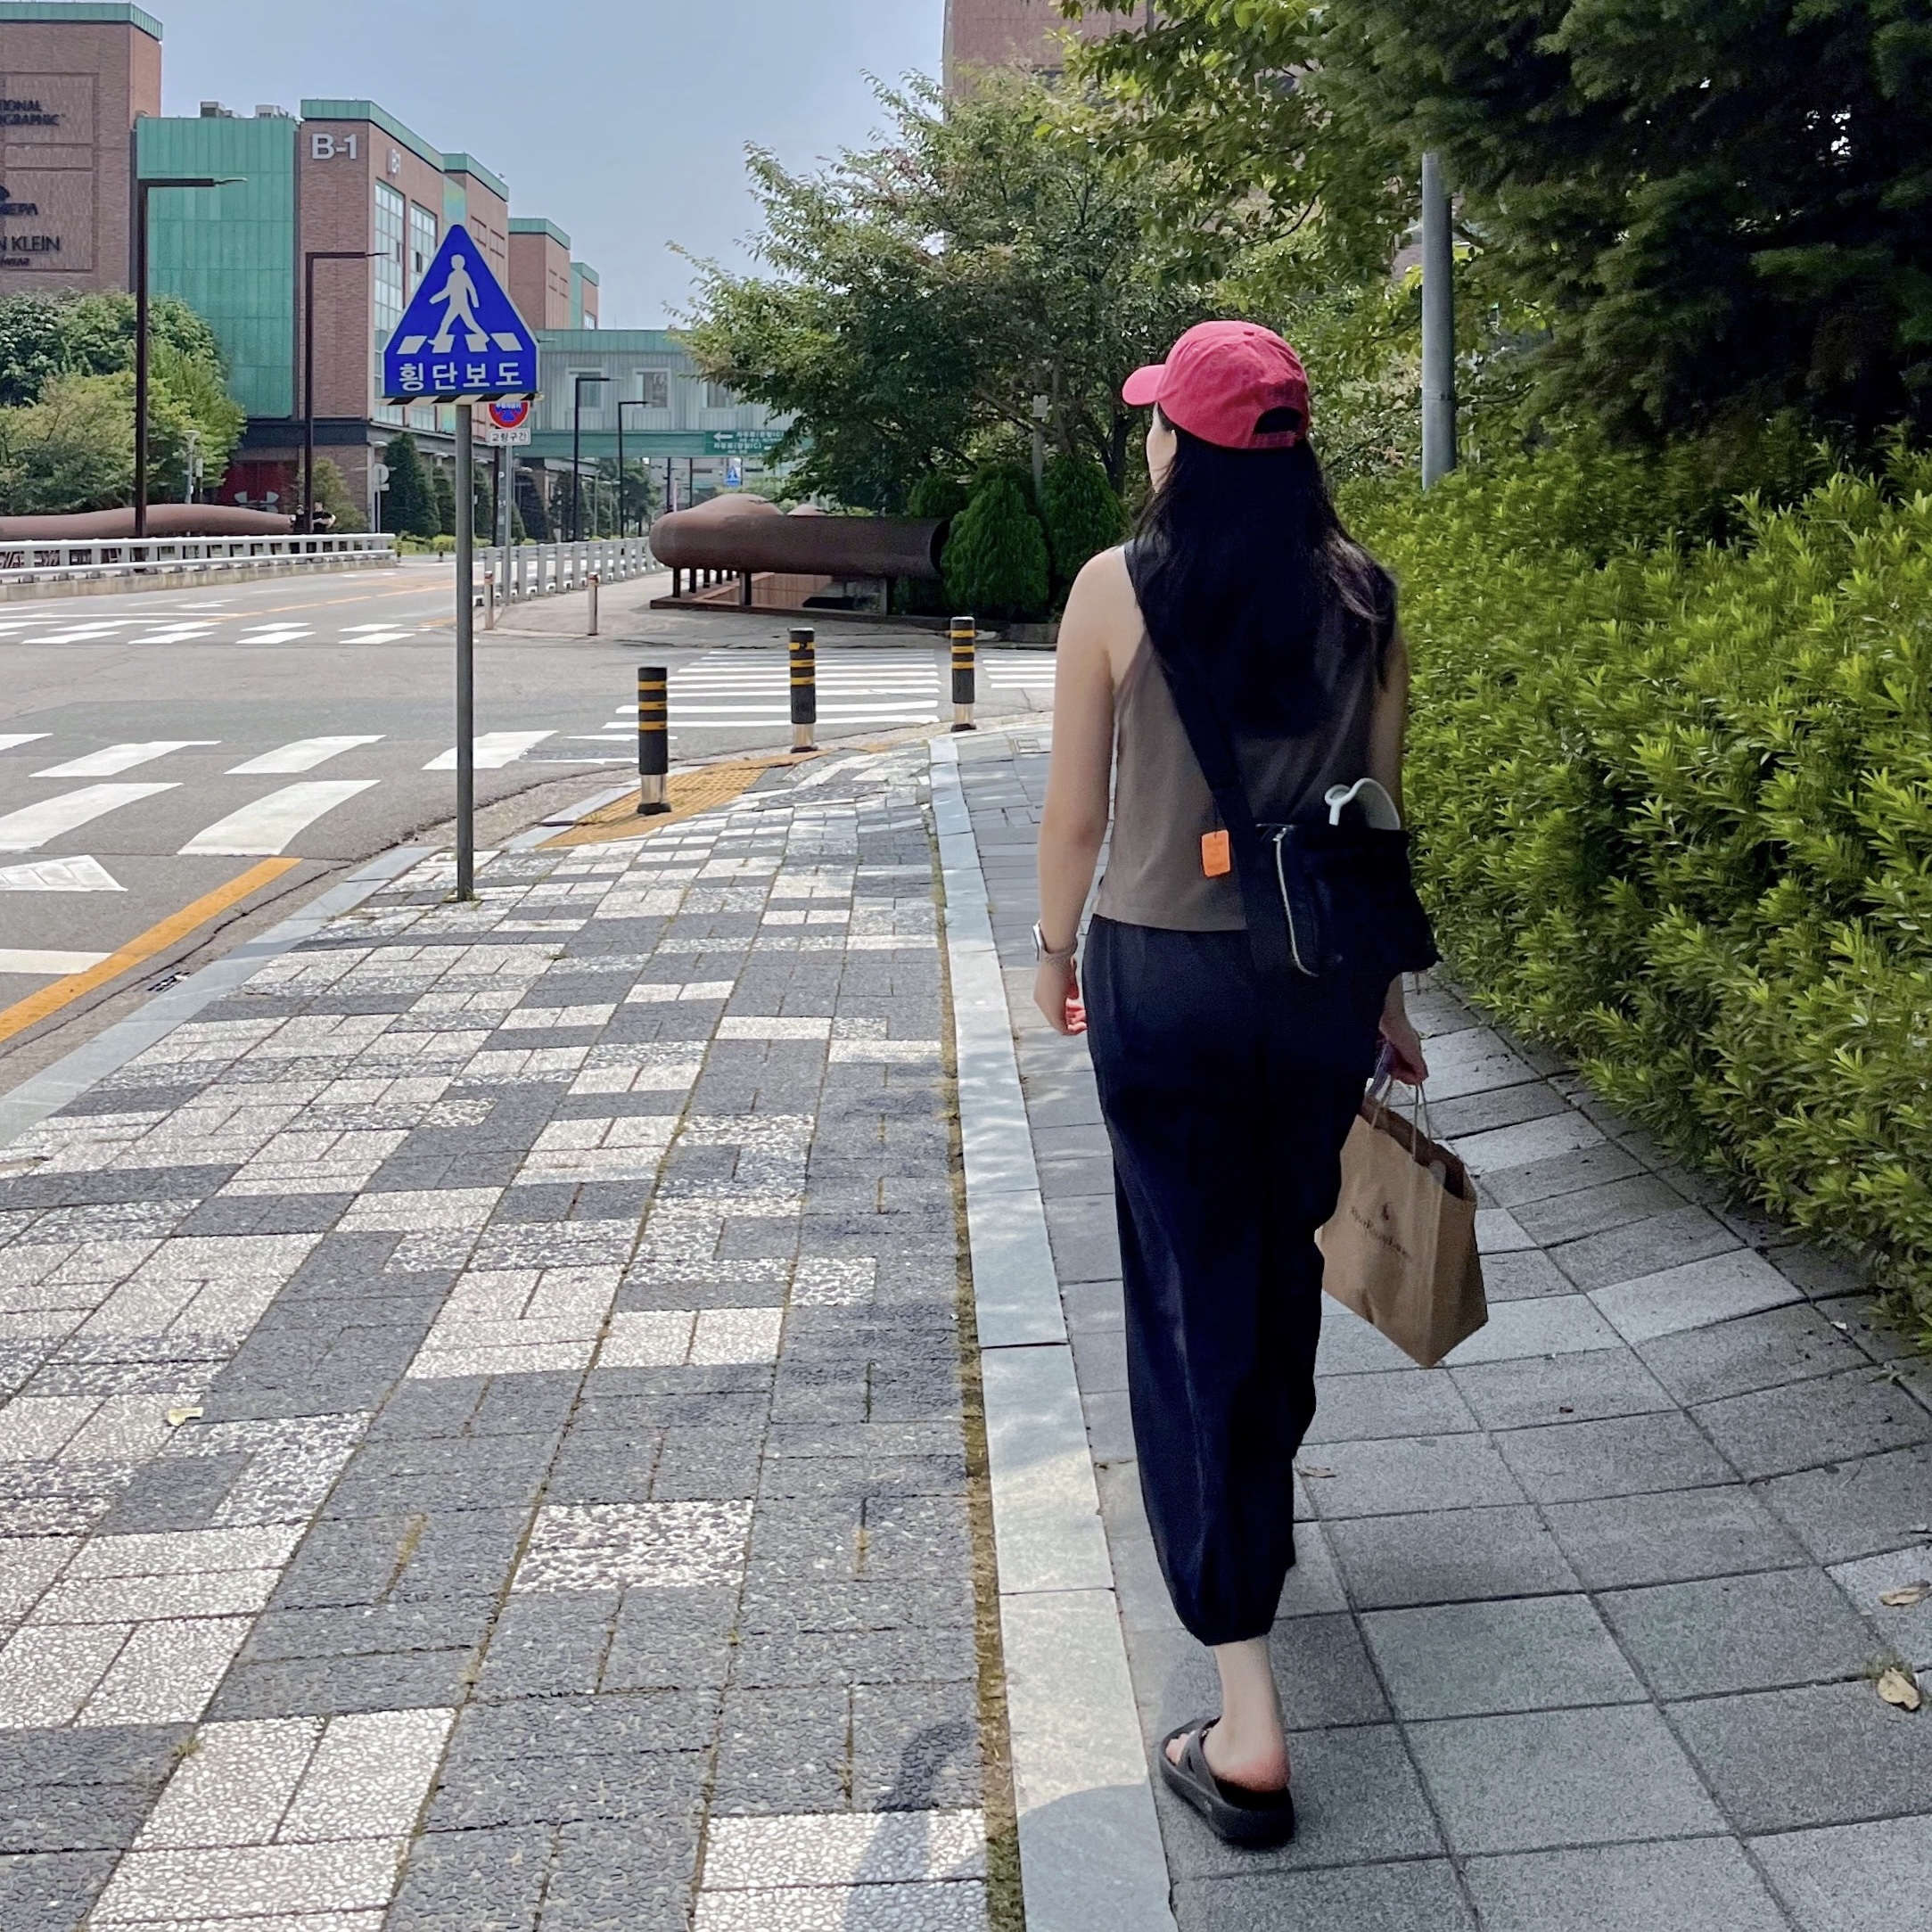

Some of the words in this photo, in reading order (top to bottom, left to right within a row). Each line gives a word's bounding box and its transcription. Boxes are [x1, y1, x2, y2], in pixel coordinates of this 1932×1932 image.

[312, 133, 357, 160] B-1
[12, 235, 60, 251] KLEIN
[399, 361, 523, 391] 횡단보도
